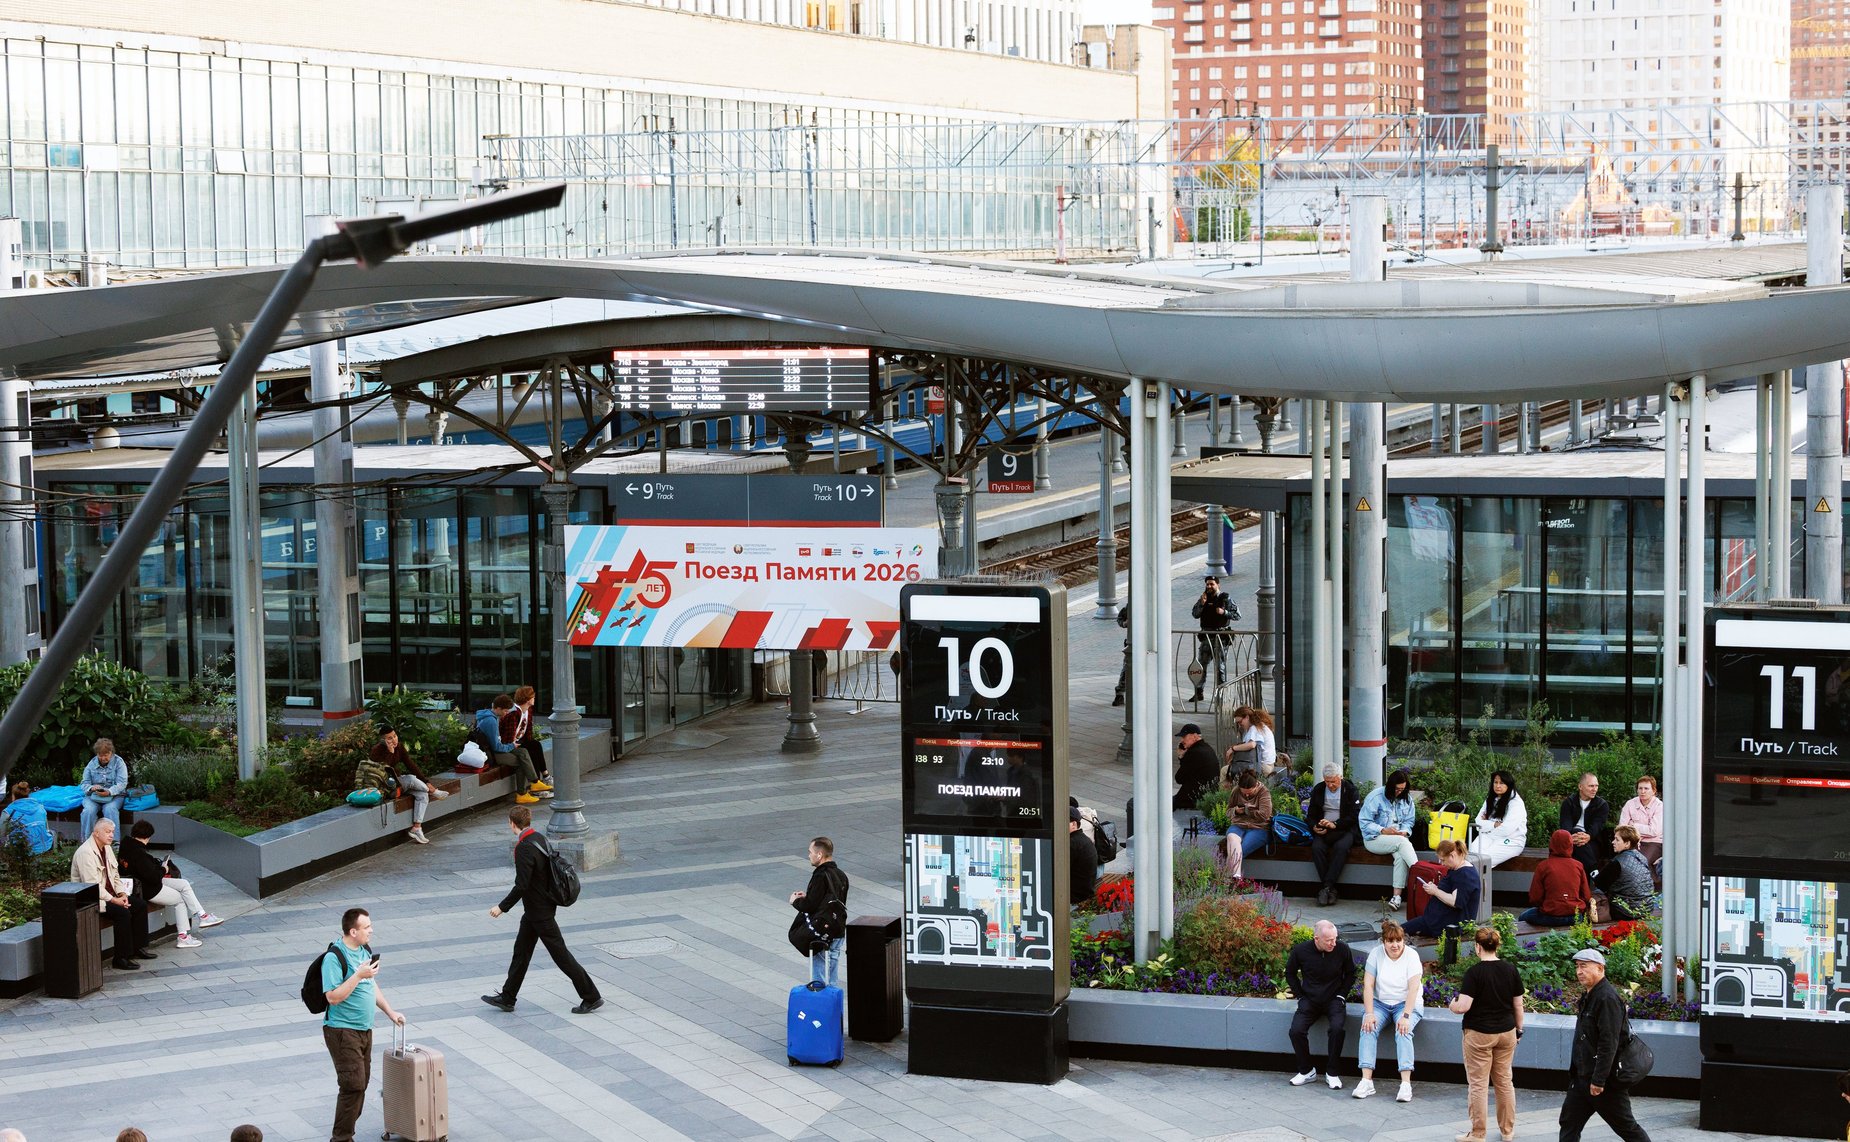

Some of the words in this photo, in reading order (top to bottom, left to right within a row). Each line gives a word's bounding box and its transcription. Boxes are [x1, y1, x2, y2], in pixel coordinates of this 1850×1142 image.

[672, 367, 696, 375] Москва
[700, 367, 719, 375] Усово
[827, 375, 831, 383] 7
[827, 401, 832, 409] 5
[1002, 453, 1018, 477] 9
[642, 482, 654, 500] 9
[655, 483, 674, 493] Путь
[813, 484, 832, 493] Путь
[835, 484, 857, 501] 10
[991, 483, 1010, 493] Путь
[656, 492, 674, 500] Track
[813, 493, 832, 501] Track
[685, 561, 759, 584] Поезд
[766, 561, 856, 582] Памяти
[864, 562, 921, 582] 2026
[645, 584, 665, 593] ЛЕТ
[937, 637, 1014, 699] 10
[1759, 664, 1817, 730] 11
[934, 705, 972, 722] Путь
[984, 708, 1020, 722] Track
[947, 739, 972, 747] Прибытие
[1740, 737, 1784, 757] Путь
[1798, 741, 1838, 756] Track
[981, 757, 1004, 766] 23:10
[1752, 777, 1781, 785] Прибытие
[1786, 778, 1823, 786] Отправление
[938, 784, 974, 797] ПОЕЗД
[974, 785, 1021, 798] ПАМЯТИ
[1019, 807, 1040, 816] 20:51
